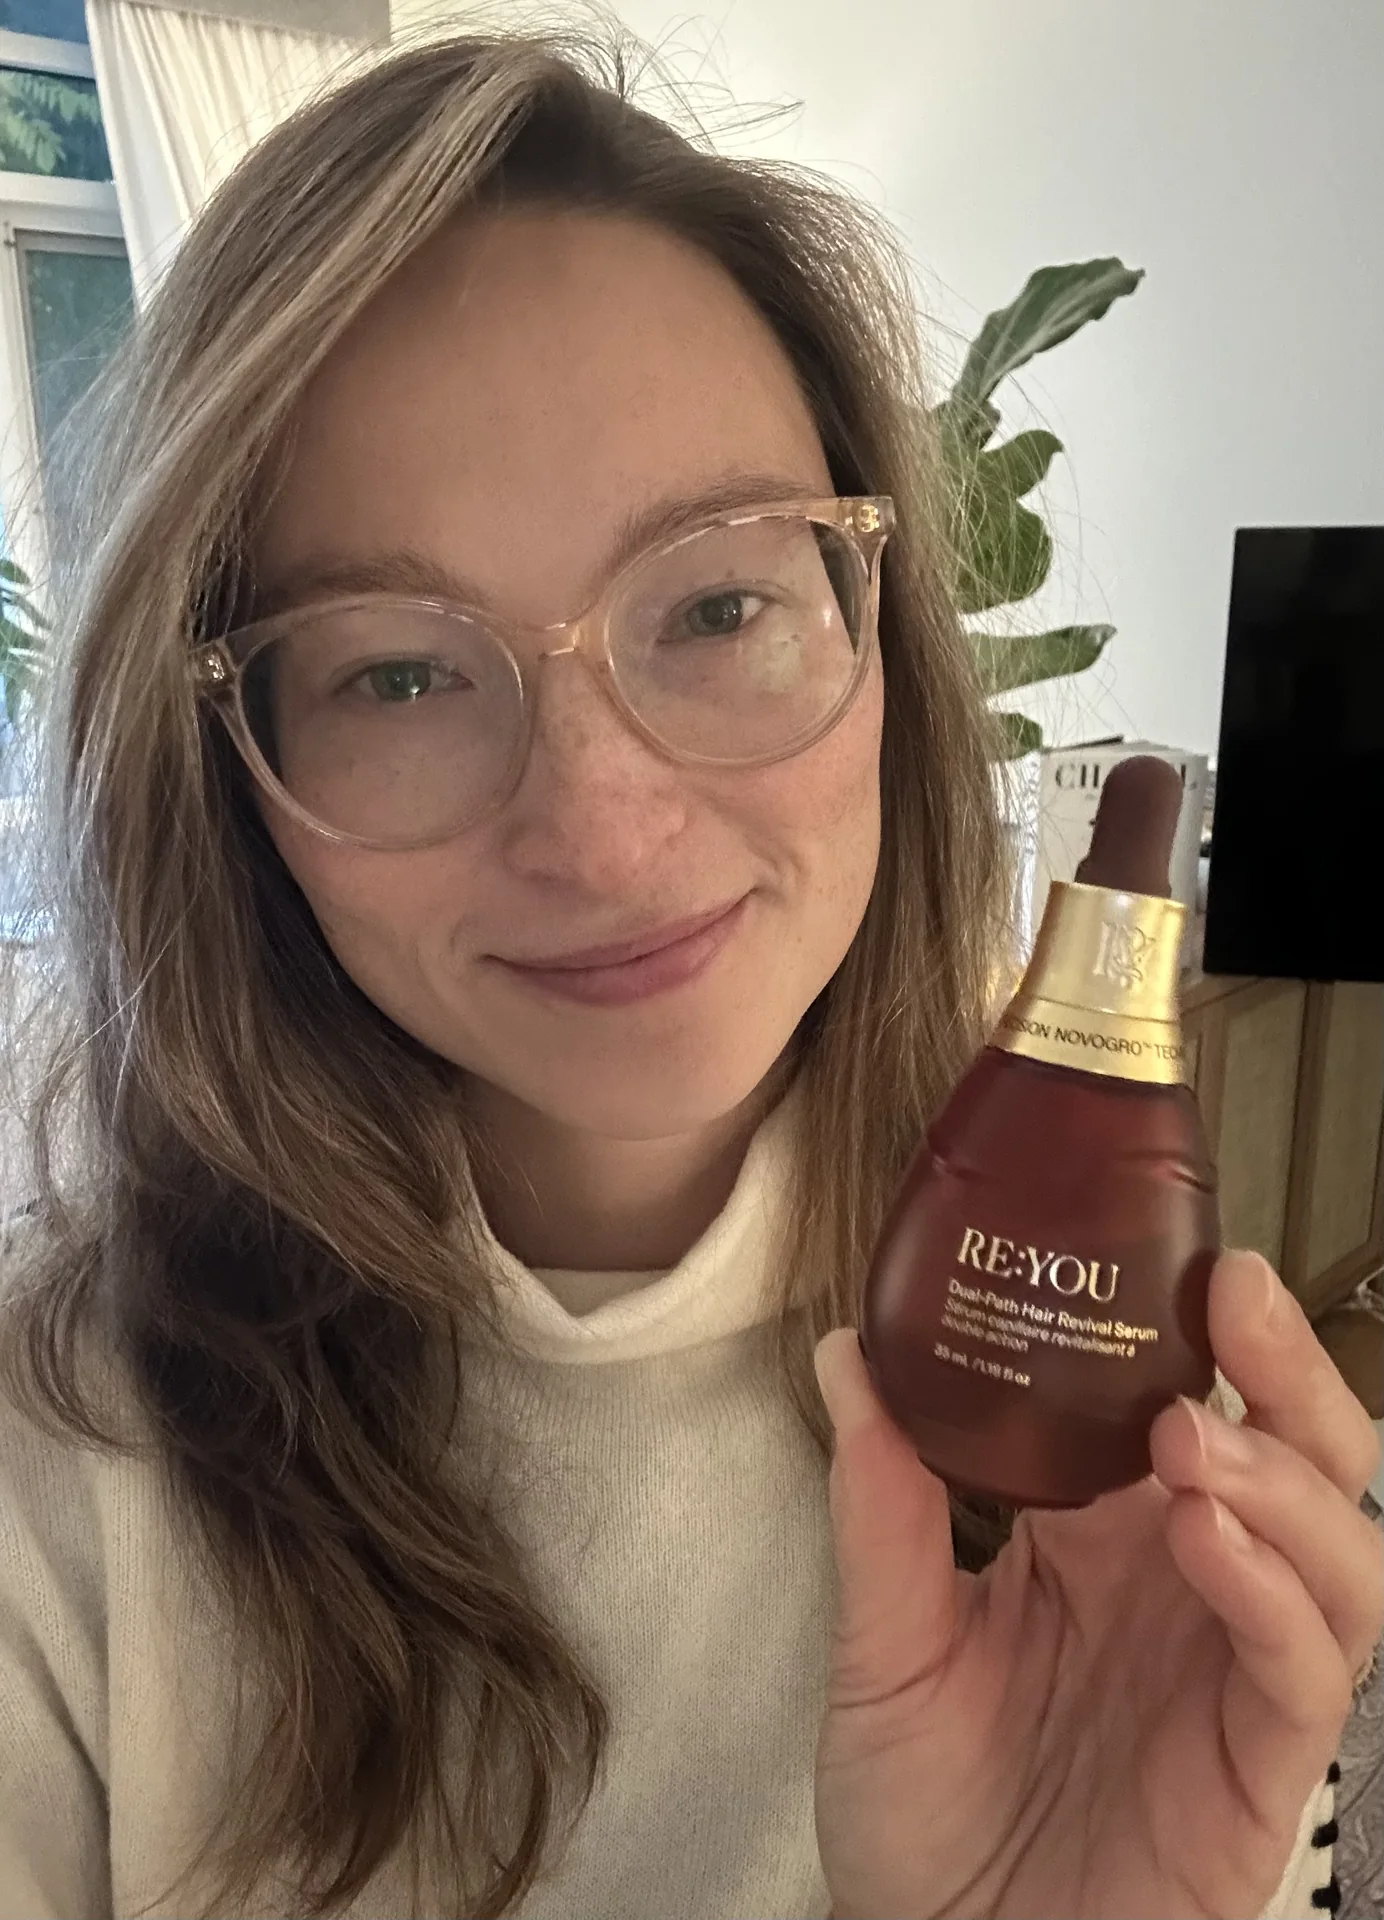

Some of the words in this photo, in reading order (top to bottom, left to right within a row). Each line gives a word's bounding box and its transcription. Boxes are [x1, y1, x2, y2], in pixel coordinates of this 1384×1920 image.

[957, 1226, 1120, 1304] RE:YOU
[948, 1277, 1019, 1315] Dual-Path
[1021, 1302, 1056, 1324] Hair
[1057, 1311, 1112, 1336] Revival
[1114, 1321, 1159, 1342] Serum
